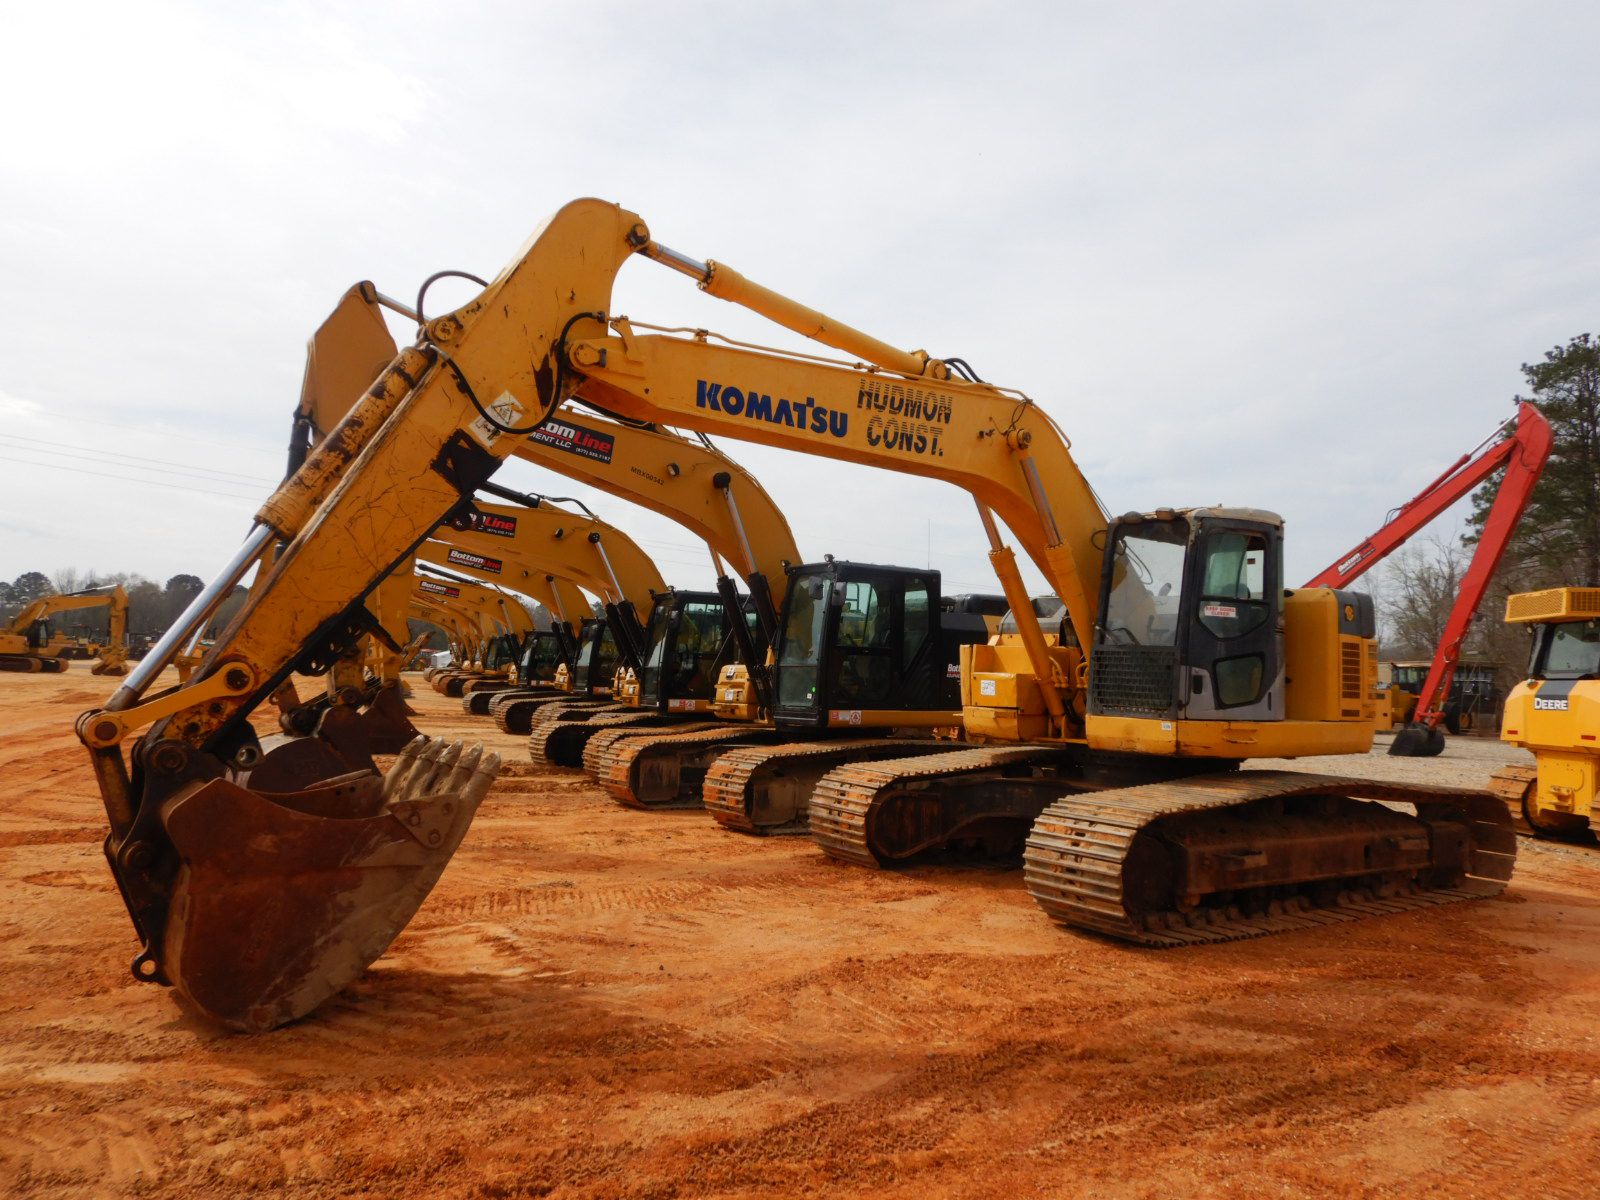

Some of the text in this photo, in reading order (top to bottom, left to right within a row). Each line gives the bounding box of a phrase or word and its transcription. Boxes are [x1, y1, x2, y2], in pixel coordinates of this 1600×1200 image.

[696, 379, 849, 438] KOMATSU
[857, 378, 953, 425] HUDMON
[539, 422, 611, 453] omLine
[555, 438, 572, 448] LLC
[866, 415, 945, 457] CONST.
[1535, 698, 1568, 710] DEERE
